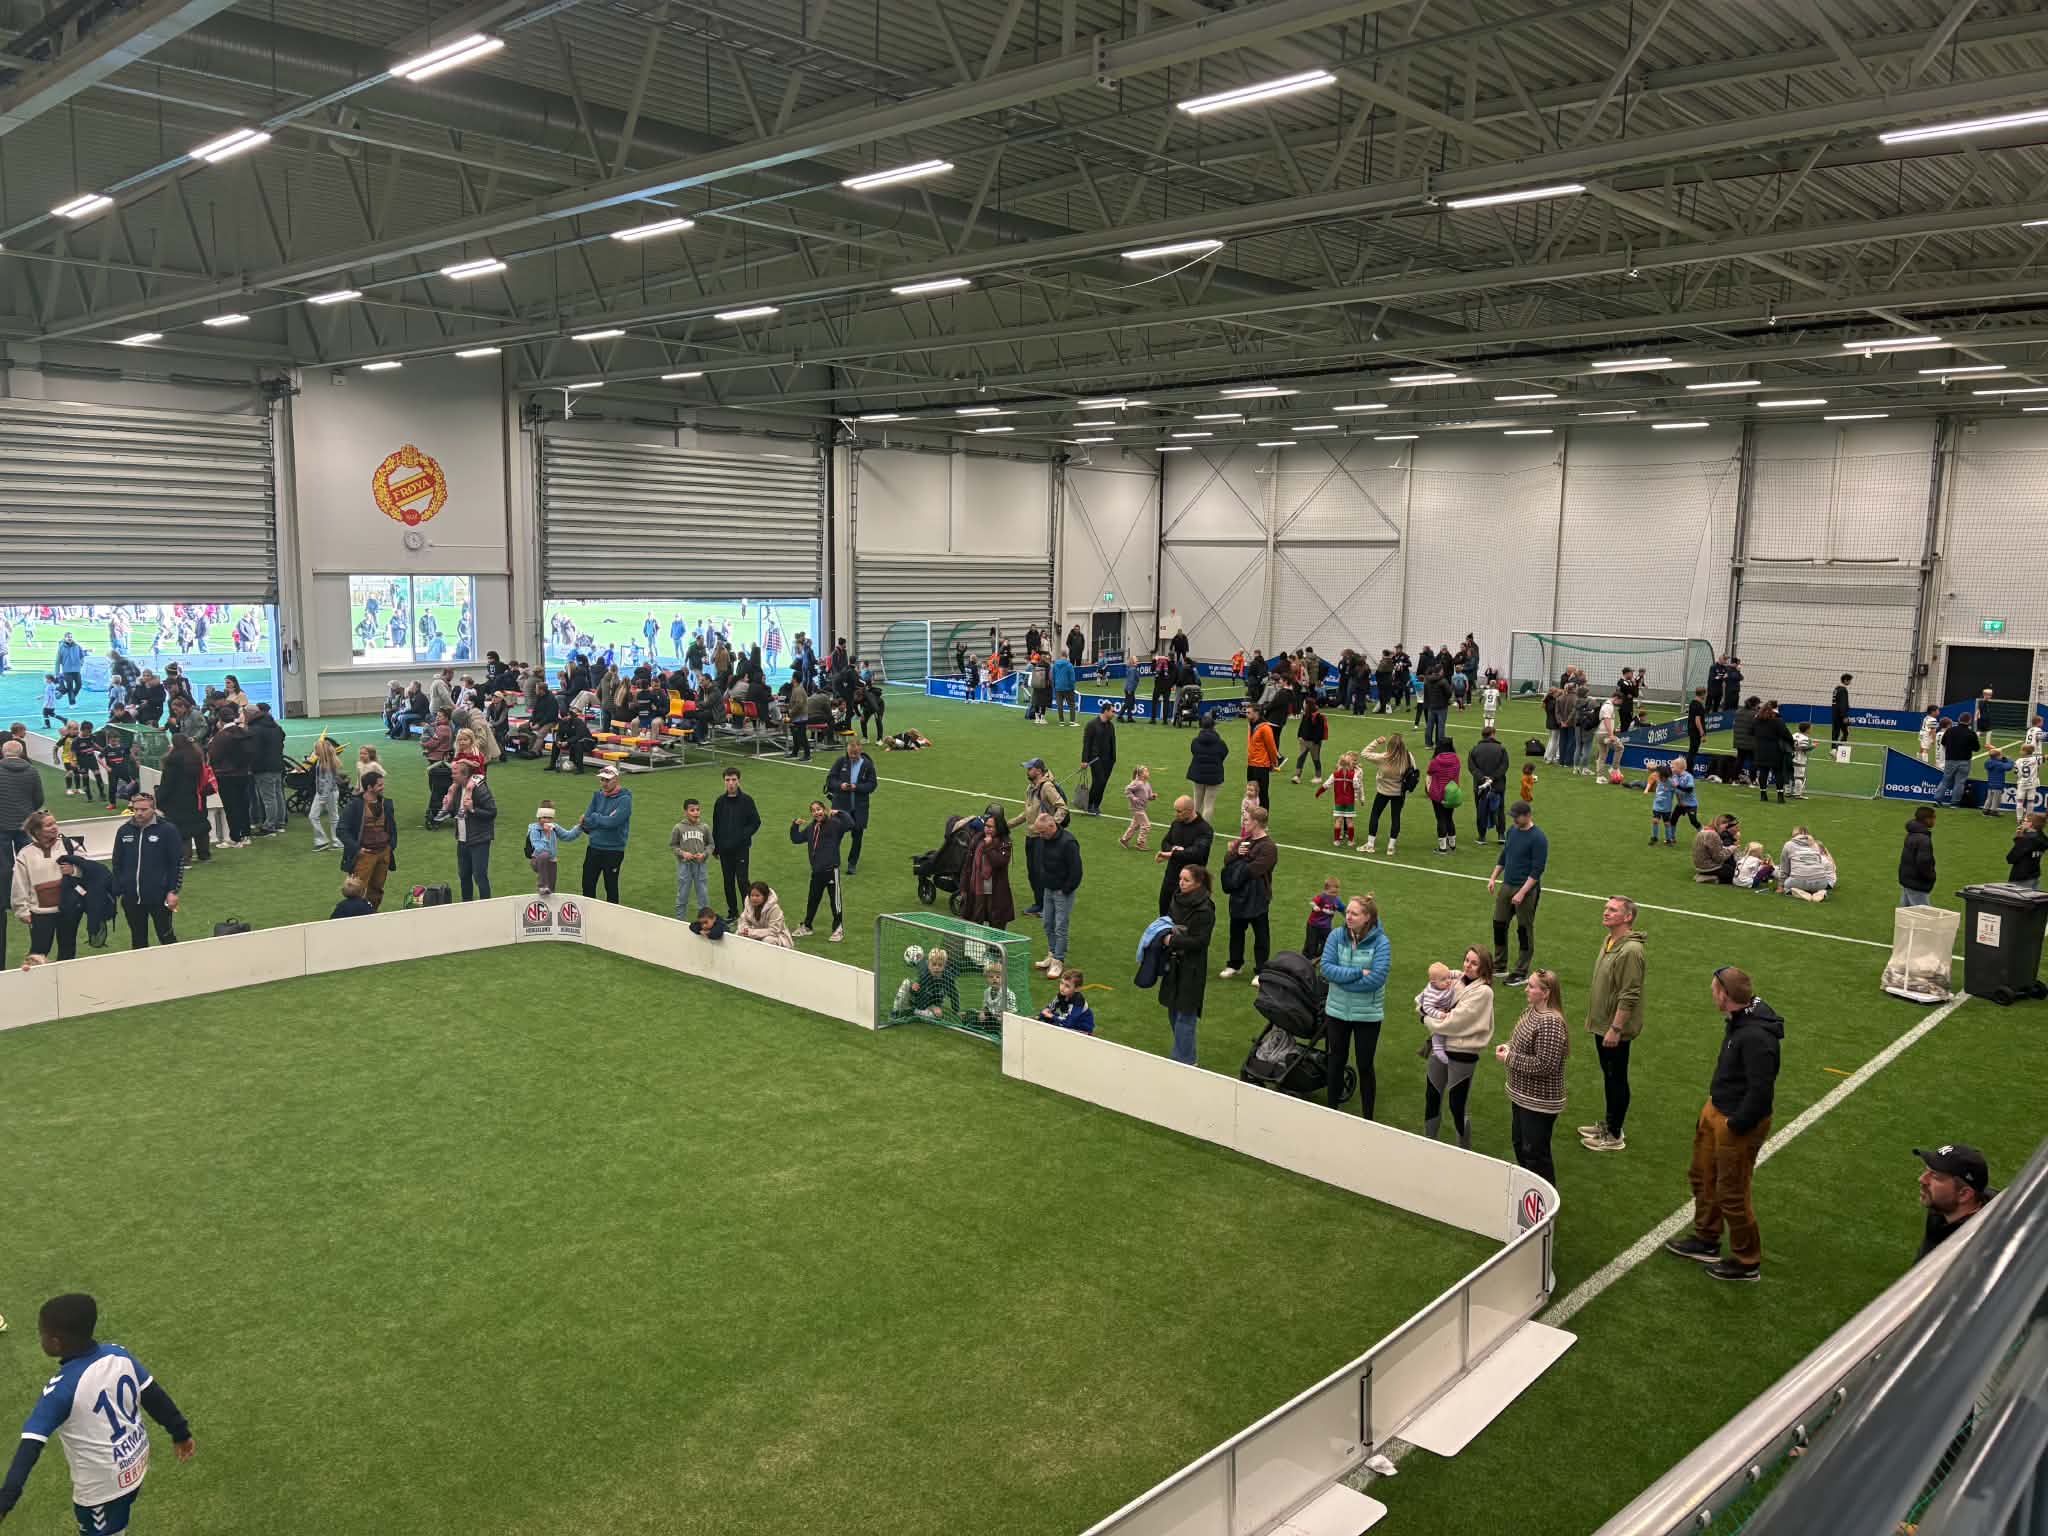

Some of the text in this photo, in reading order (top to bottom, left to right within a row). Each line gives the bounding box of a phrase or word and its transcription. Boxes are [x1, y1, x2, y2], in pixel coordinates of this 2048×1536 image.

[2021, 766, 2030, 778] 9
[1886, 784, 1910, 793] OBOS
[93, 1375, 138, 1442] 10
